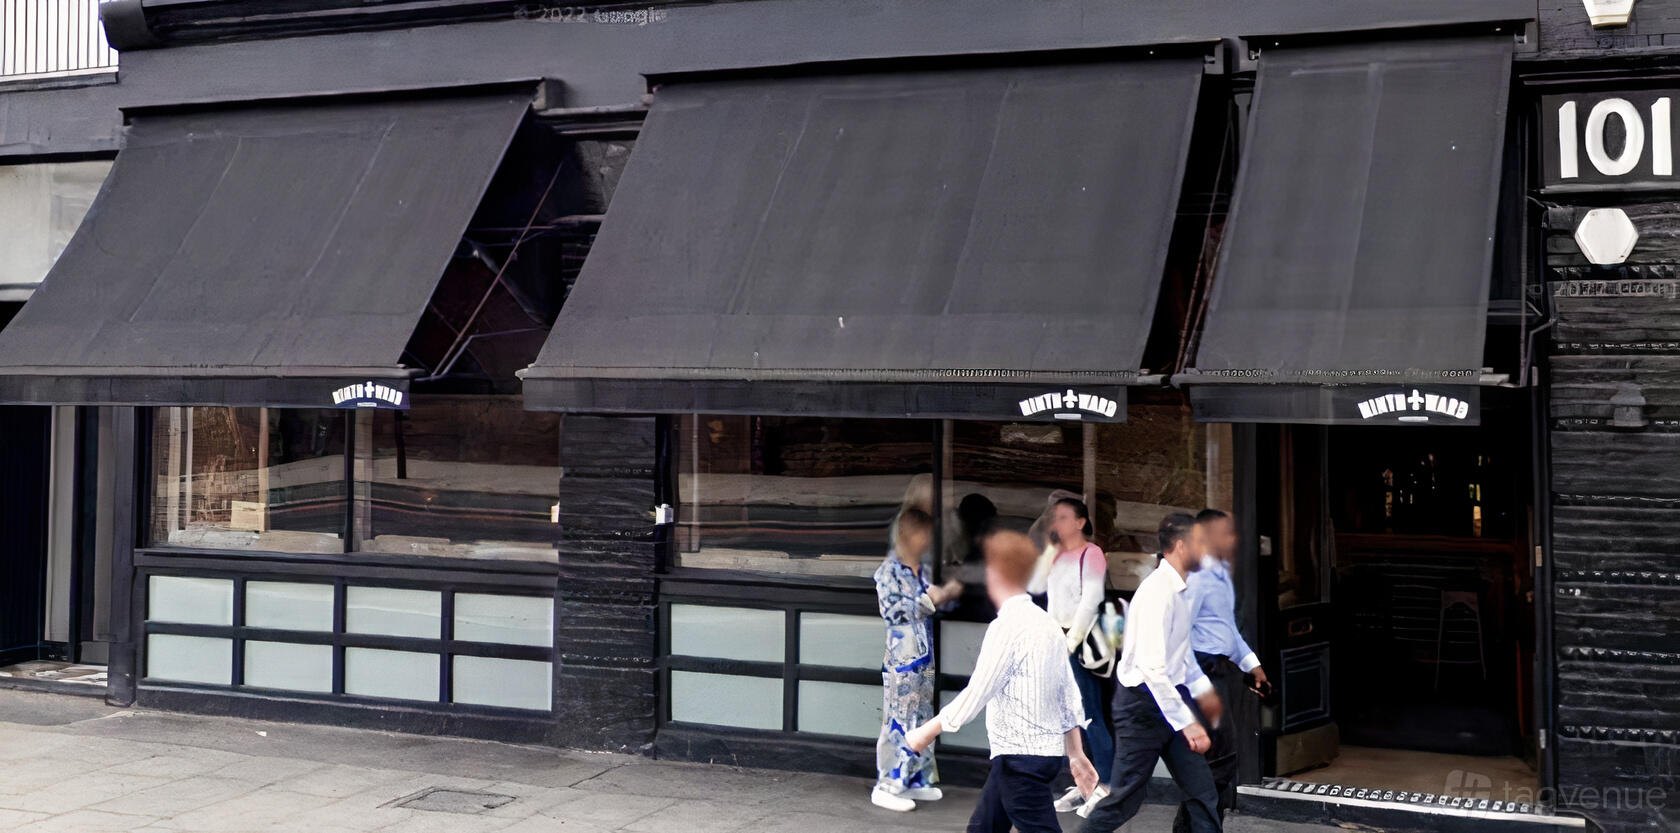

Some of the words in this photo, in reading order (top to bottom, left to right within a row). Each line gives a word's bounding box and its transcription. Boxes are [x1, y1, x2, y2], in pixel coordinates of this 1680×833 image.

[1558, 97, 1672, 179] 101
[1018, 392, 1062, 417] NINTH
[1078, 393, 1117, 418] WARD
[1357, 393, 1406, 420] NINTH
[1425, 393, 1469, 420] WARD
